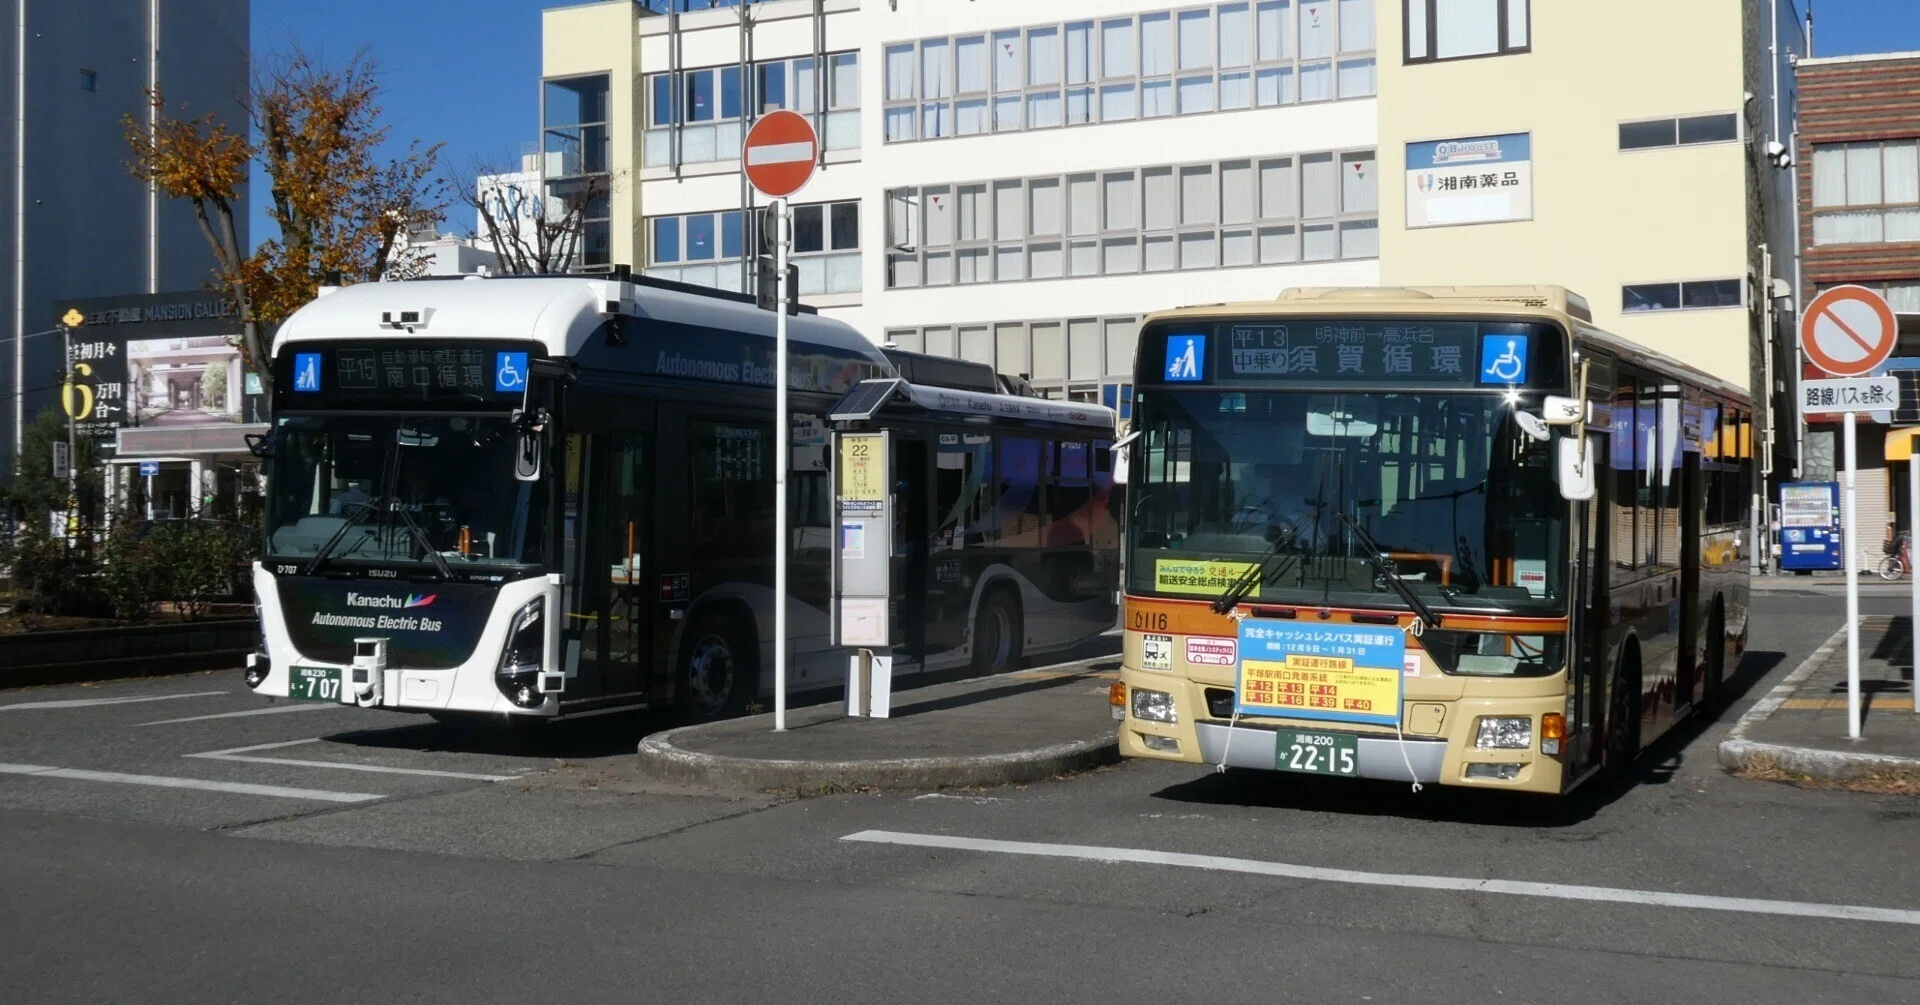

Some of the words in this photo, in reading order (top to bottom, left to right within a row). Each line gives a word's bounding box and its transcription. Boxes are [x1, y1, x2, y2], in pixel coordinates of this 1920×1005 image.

[1438, 172, 1519, 191] 湘南薬品
[145, 305, 193, 321] MANSION
[195, 301, 241, 318] GALLE
[340, 358, 375, 381] 平15
[656, 351, 739, 381] Autonomous
[1235, 351, 1287, 369] 中乗り
[1806, 385, 1894, 406] 路線バスを除く
[852, 444, 868, 456] 22
[368, 569, 397, 578] ISUZU
[347, 592, 402, 608] Kanachu
[312, 612, 375, 628] Autonomous
[377, 615, 418, 631] Electric
[420, 618, 442, 632] Bus
[1292, 657, 1347, 669] 実証運行路線
[1280, 751, 1288, 760] か
[1289, 744, 1354, 774] 22-15
